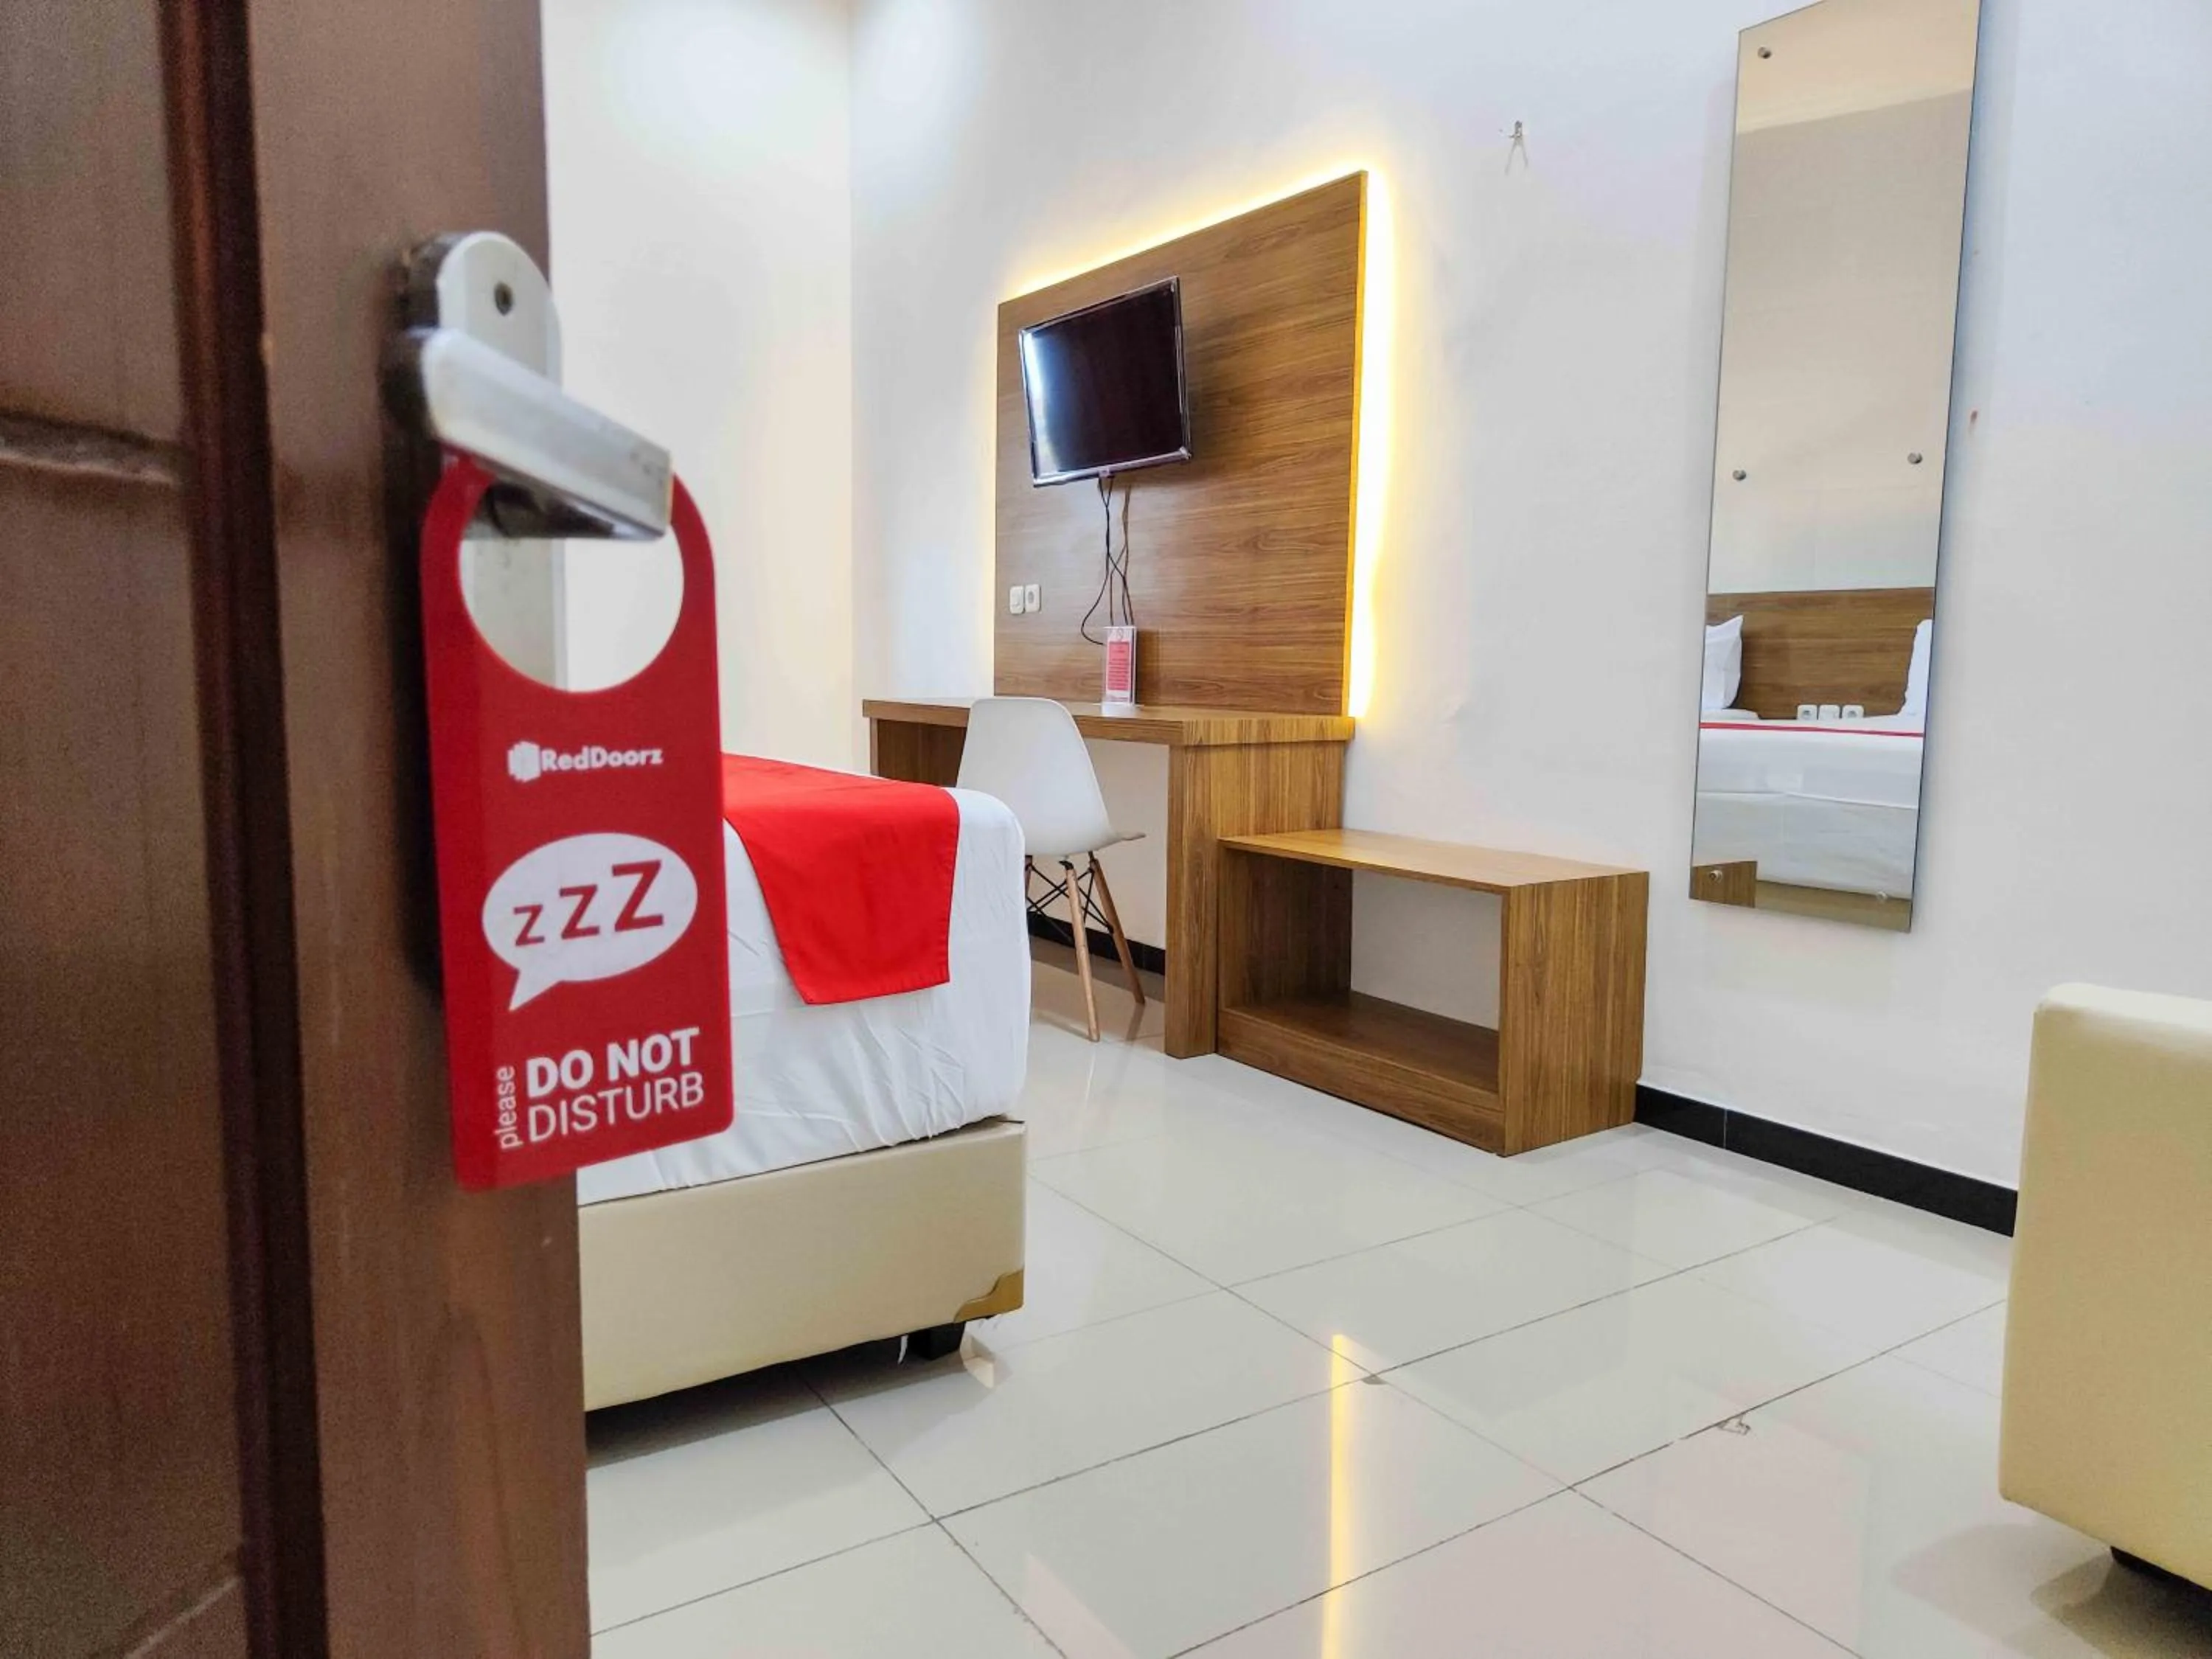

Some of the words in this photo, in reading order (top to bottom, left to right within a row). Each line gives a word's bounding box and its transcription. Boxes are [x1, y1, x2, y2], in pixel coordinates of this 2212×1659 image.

[540, 745, 663, 772] RedDoorz
[526, 1048, 594, 1099] DO
[607, 1026, 700, 1082] NOT
[494, 1065, 523, 1150] please
[528, 1071, 704, 1143] DISTURB
